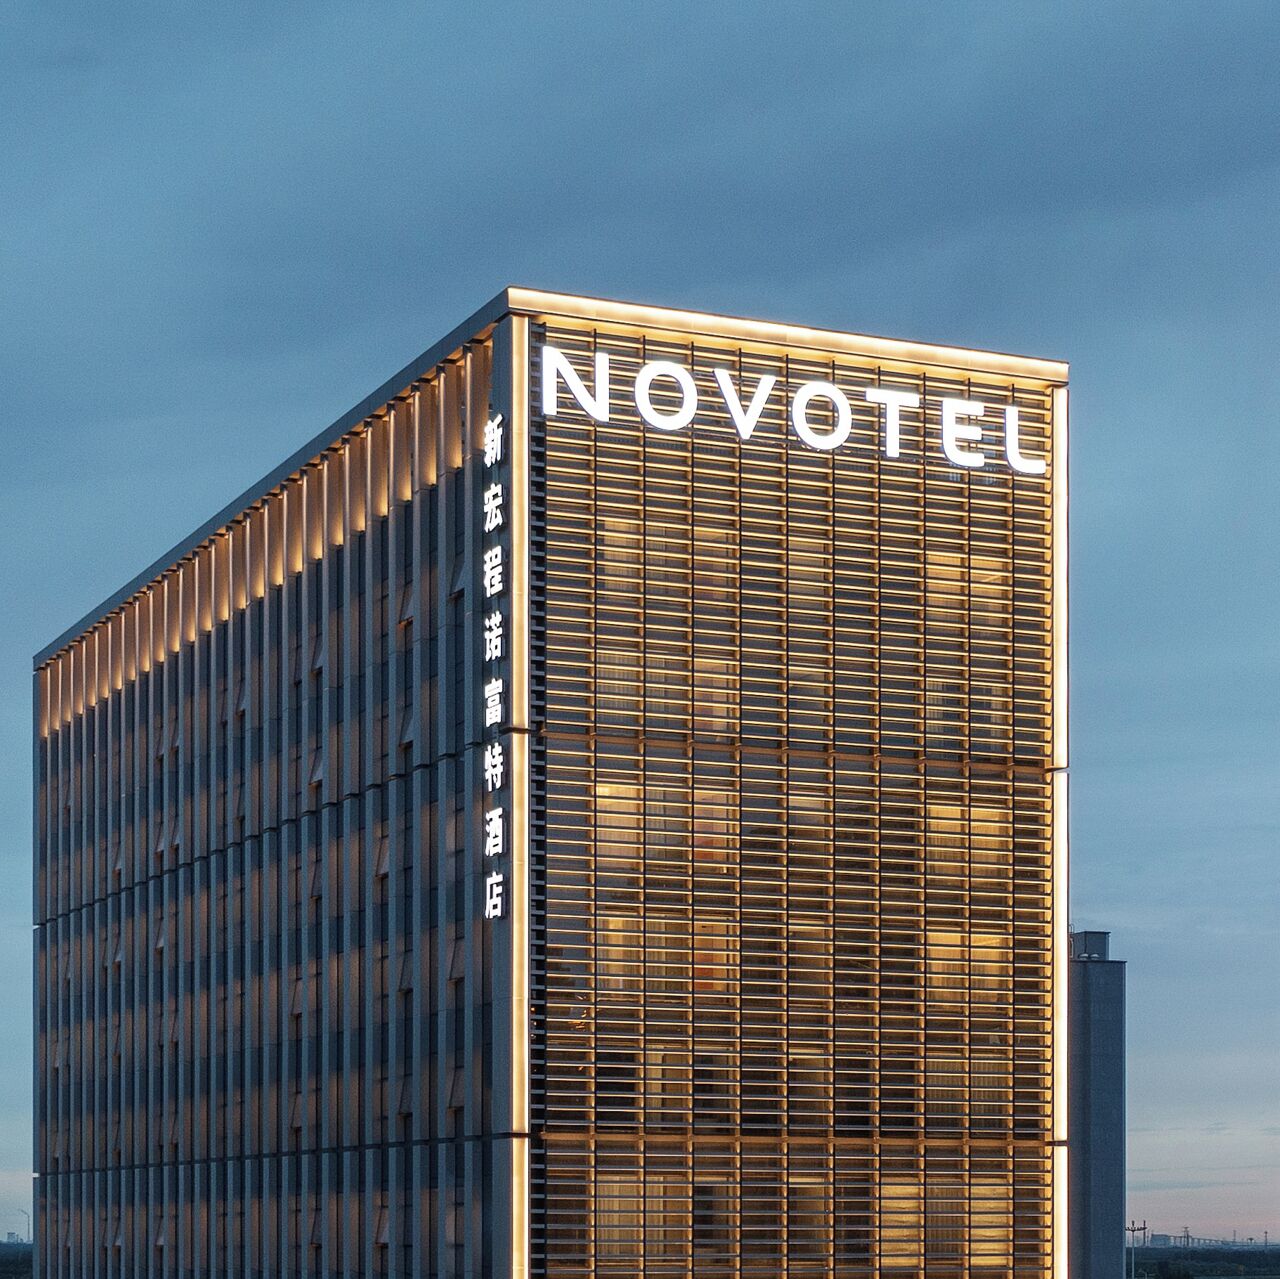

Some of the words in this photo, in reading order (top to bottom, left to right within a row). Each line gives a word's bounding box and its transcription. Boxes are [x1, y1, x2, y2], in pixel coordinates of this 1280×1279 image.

[542, 345, 1047, 475] NOVOTEL
[483, 414, 504, 919] 新宏程诺富特酒店
